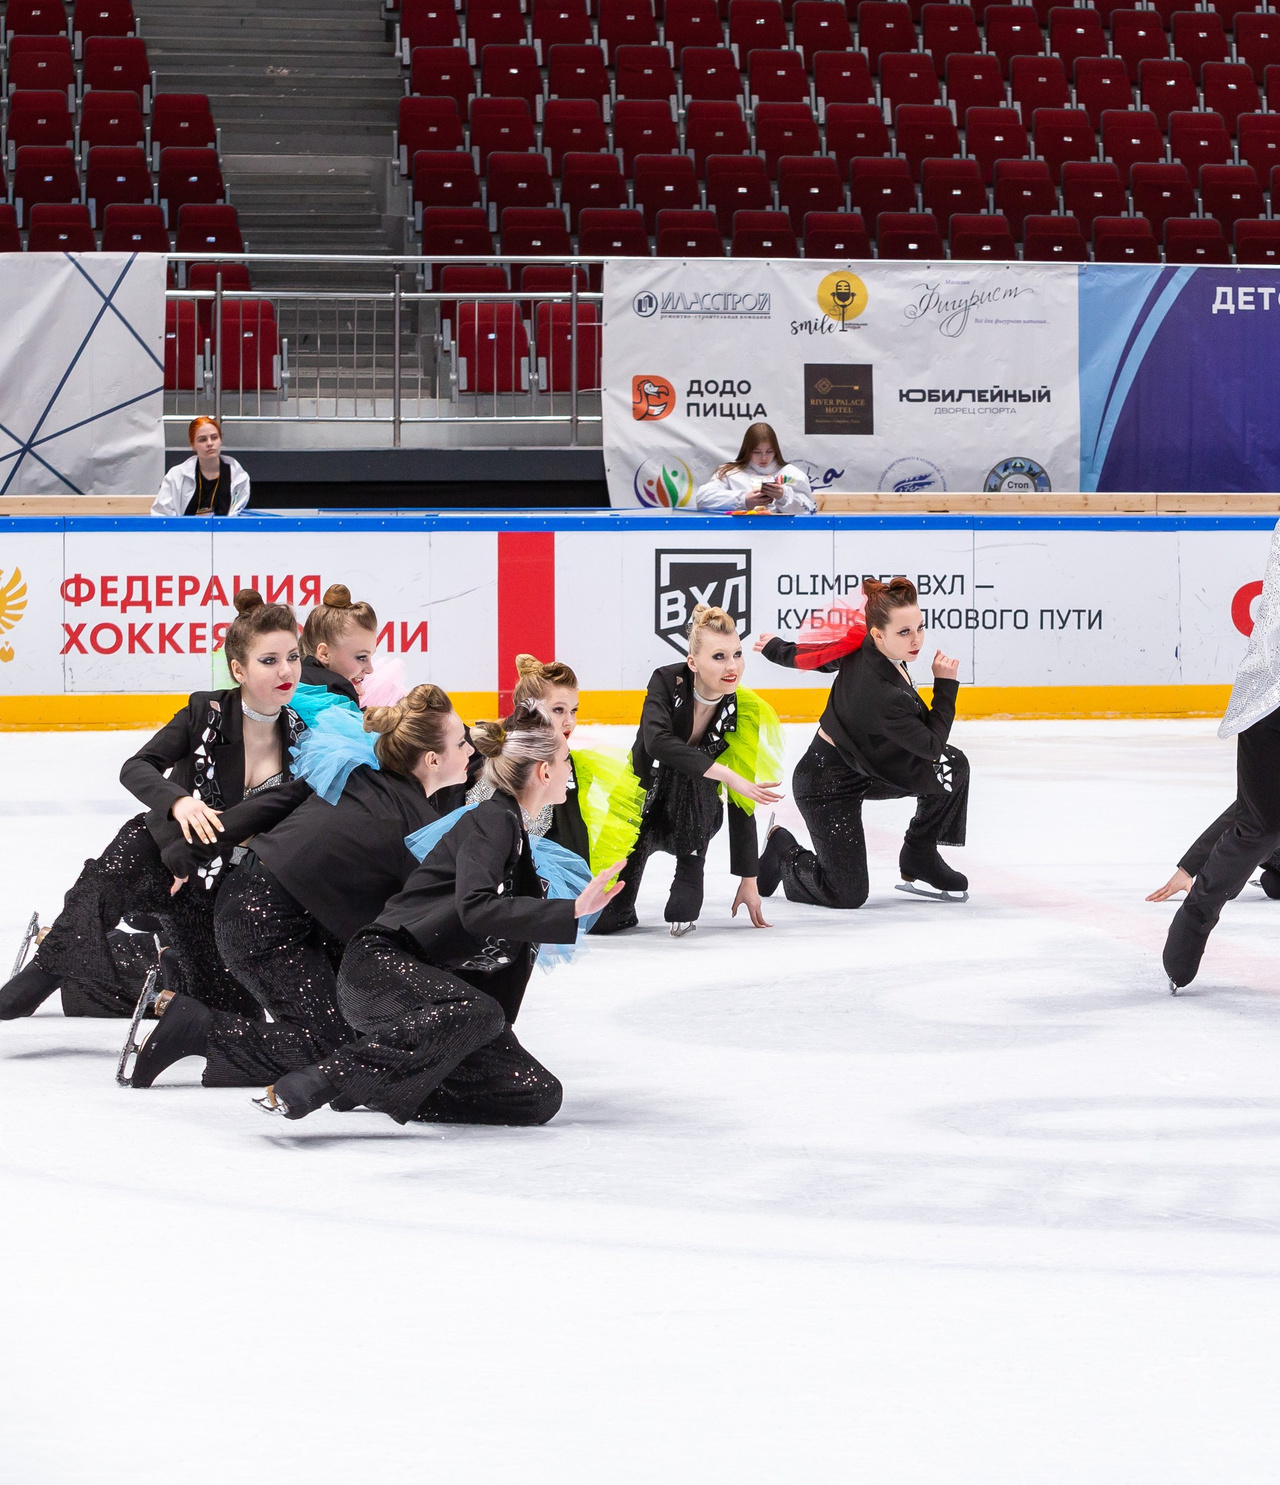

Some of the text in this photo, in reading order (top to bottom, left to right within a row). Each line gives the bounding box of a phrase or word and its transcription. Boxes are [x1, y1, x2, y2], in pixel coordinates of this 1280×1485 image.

[790, 313, 836, 335] smile
[686, 379, 752, 397] ДОДО
[898, 385, 1052, 403] ЮБИЛЕЙНЫЙ
[686, 402, 768, 420] ПИЦЦА
[810, 398, 866, 406] RIVER PALACE
[934, 407, 976, 415] ДВОРЕЦ
[1007, 480, 1029, 489] Стоп
[917, 574, 965, 595] ВХЛ
[1039, 608, 1103, 630] ПУТИ
